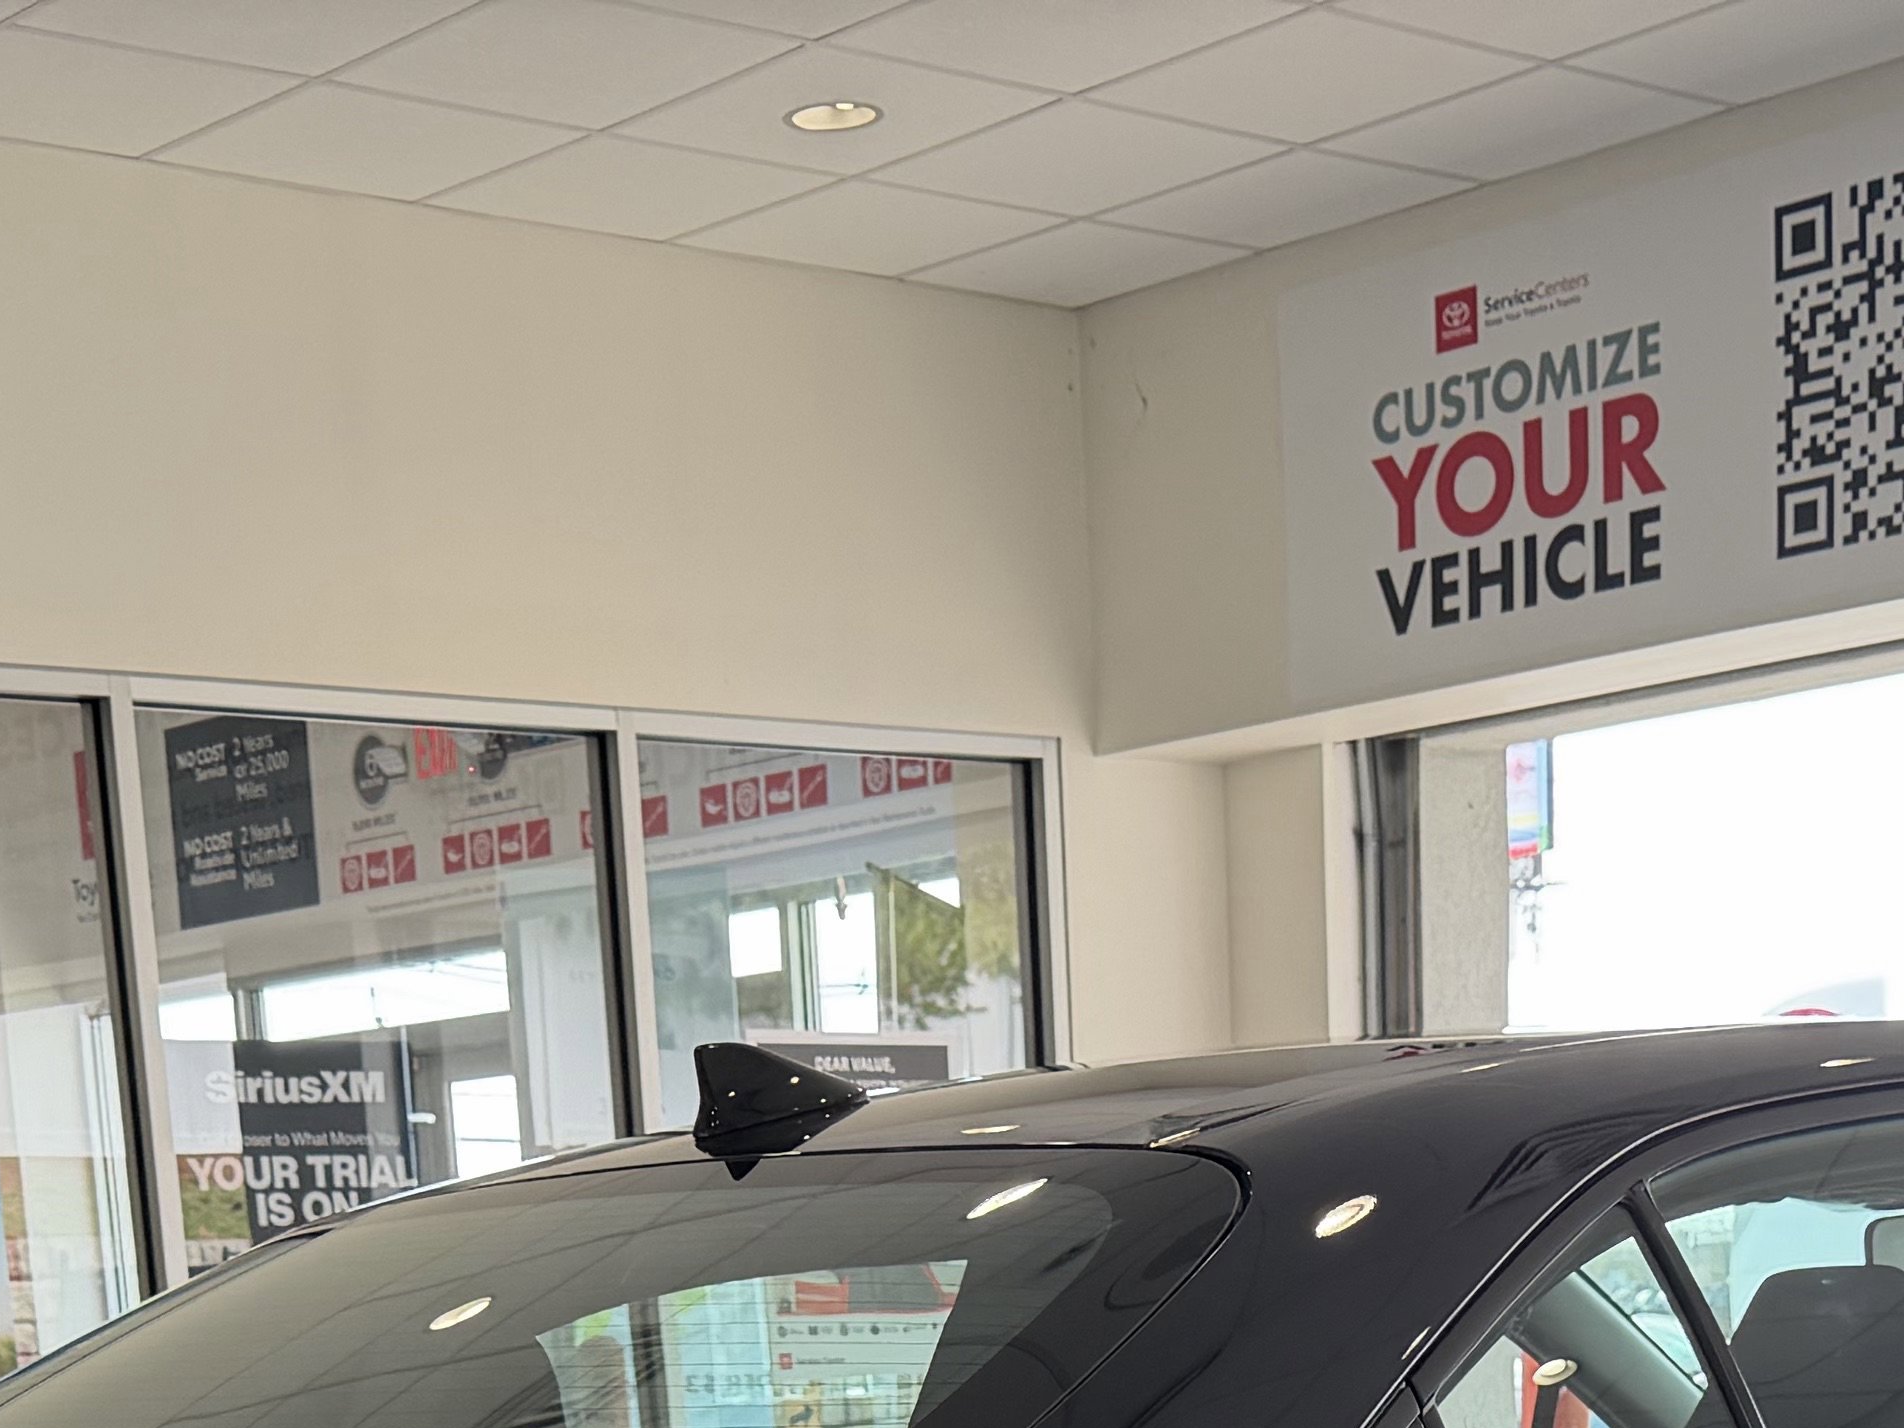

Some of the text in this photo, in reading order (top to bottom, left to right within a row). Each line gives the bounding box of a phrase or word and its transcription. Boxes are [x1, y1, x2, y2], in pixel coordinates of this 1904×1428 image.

[1372, 321, 1661, 444] CUSTOMIZE
[1371, 393, 1666, 552] YOUR
[1376, 505, 1661, 636] VEHICLE
[203, 1071, 386, 1104] SiriusXM
[187, 1155, 418, 1191] YOUR TRIAL
[256, 1191, 294, 1227] IS
